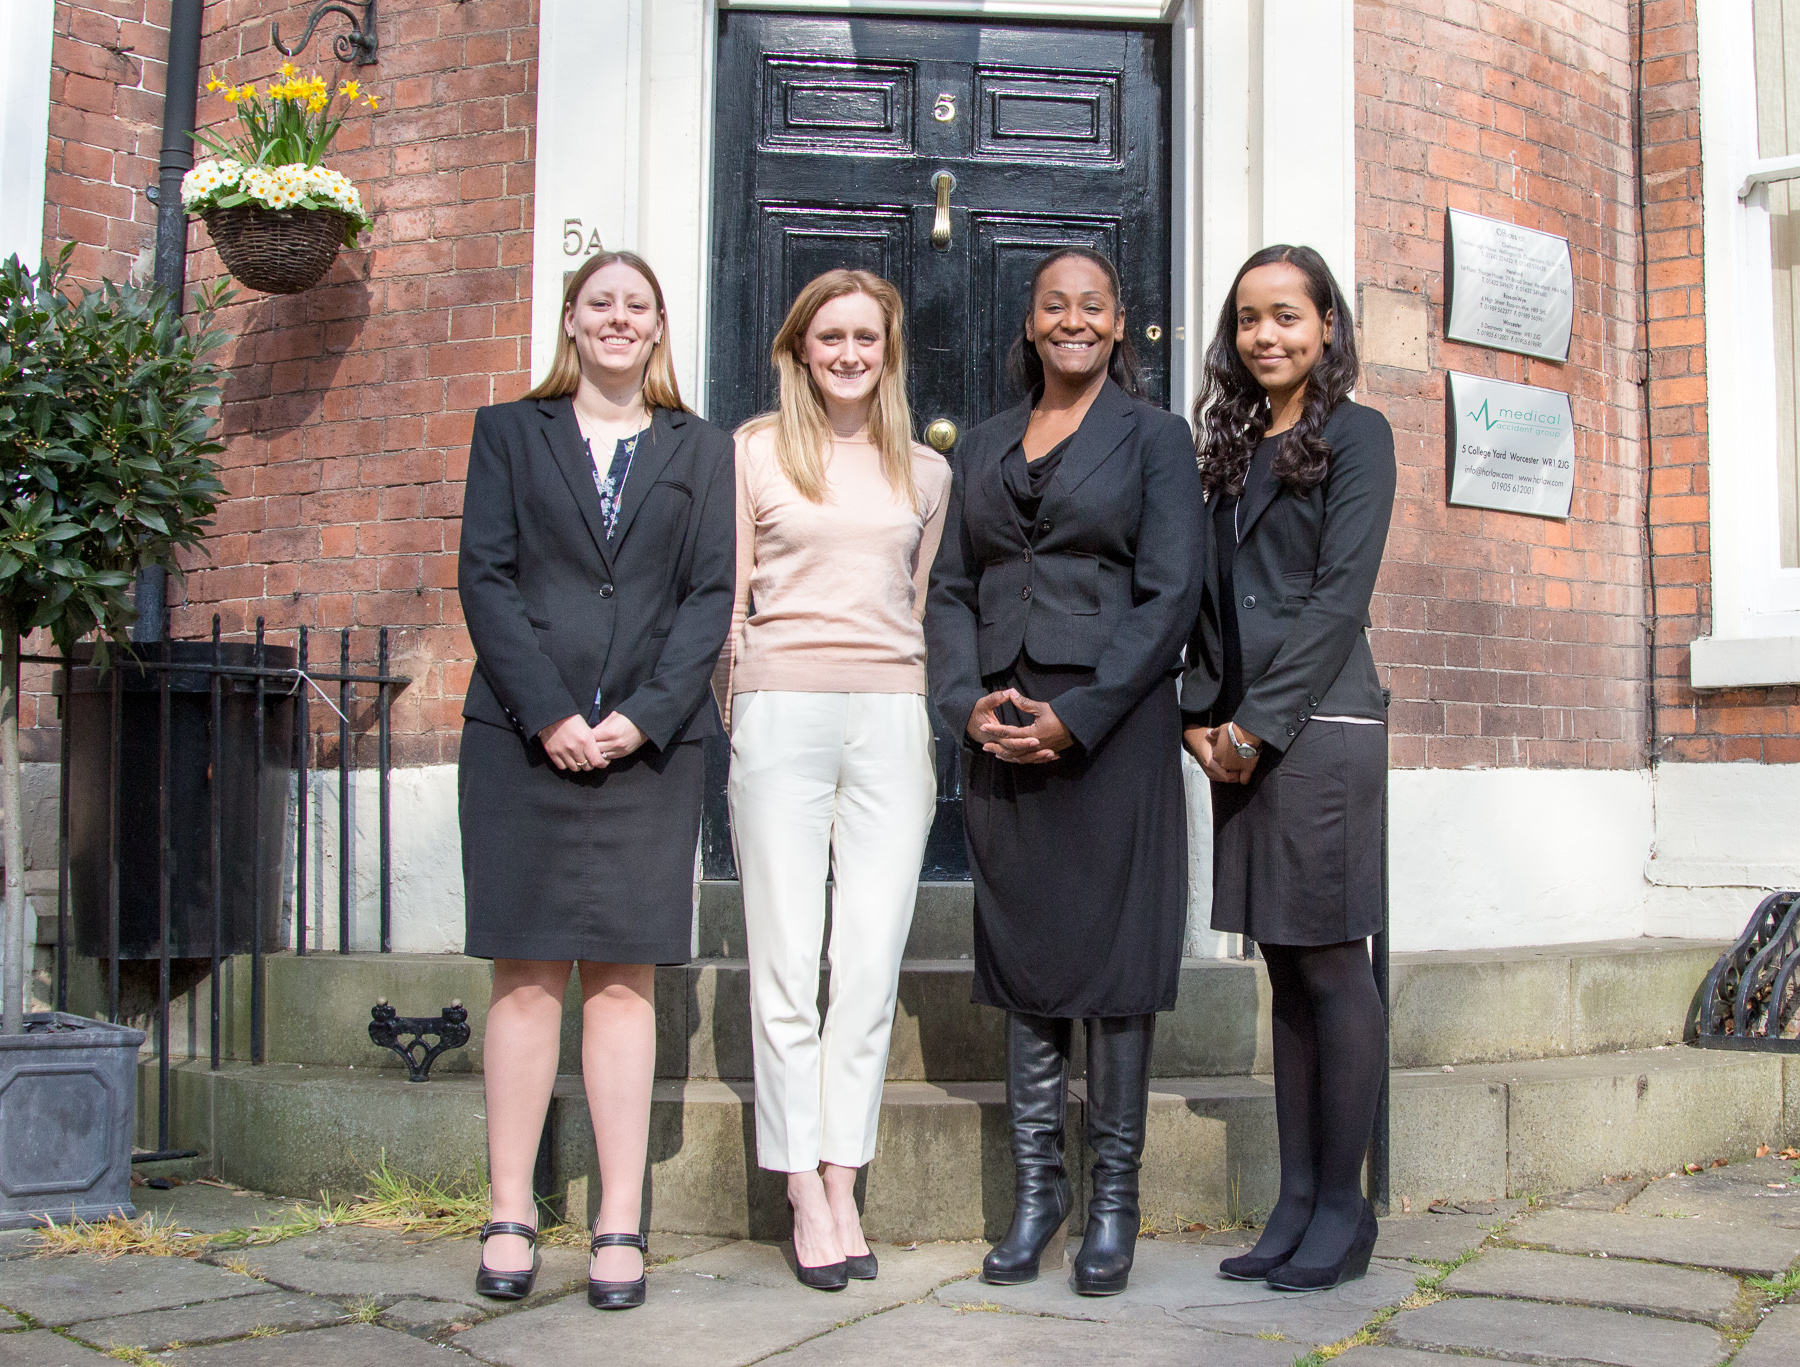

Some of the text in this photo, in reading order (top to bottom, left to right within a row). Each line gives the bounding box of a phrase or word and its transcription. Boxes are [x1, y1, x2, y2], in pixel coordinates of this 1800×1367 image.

[934, 93, 956, 122] 5
[563, 218, 605, 257] 5A
[1496, 228, 1517, 241] Offices
[1503, 319, 1522, 328] Worcester
[1500, 408, 1561, 425] medical
[1496, 423, 1561, 438] accident group
[1461, 445, 1570, 469] 5 College Yard Worcester WR1 2JG
[1464, 465, 1564, 487] info@hcrlaw.com www.hcrlaw.com
[1491, 481, 1535, 495] 01905 612001
